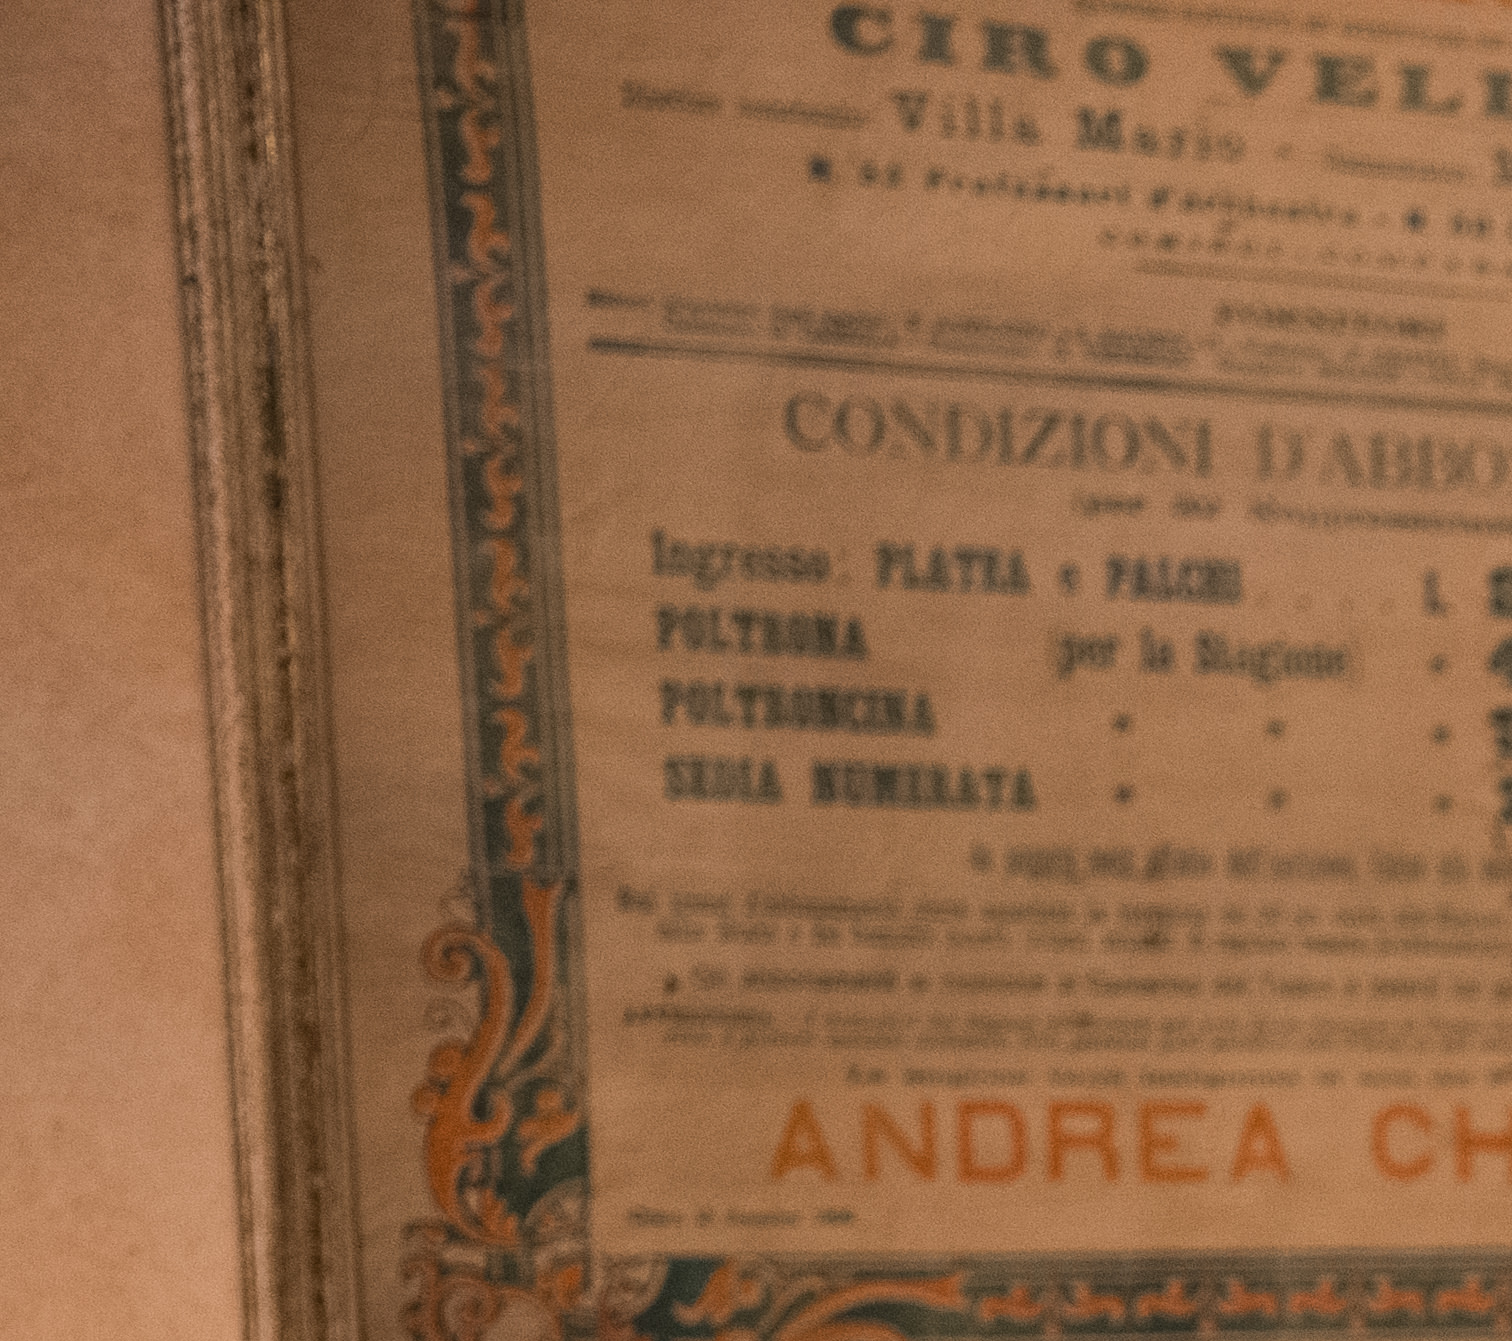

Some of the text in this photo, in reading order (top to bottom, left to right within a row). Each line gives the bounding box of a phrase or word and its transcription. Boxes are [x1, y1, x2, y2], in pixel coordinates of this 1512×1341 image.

[830, 3, 1149, 88] CIRO
[782, 391, 1213, 480] CONDIZIONI
[875, 540, 1032, 597] PLATEA
[1104, 552, 1242, 605] PALCHI
[655, 604, 868, 662] POLTRONA
[659, 678, 935, 738] POLTRONCINA
[663, 754, 783, 804] SEDIA
[810, 757, 1036, 813] NUMERATA
[769, 1097, 1297, 1186] ANDREA
